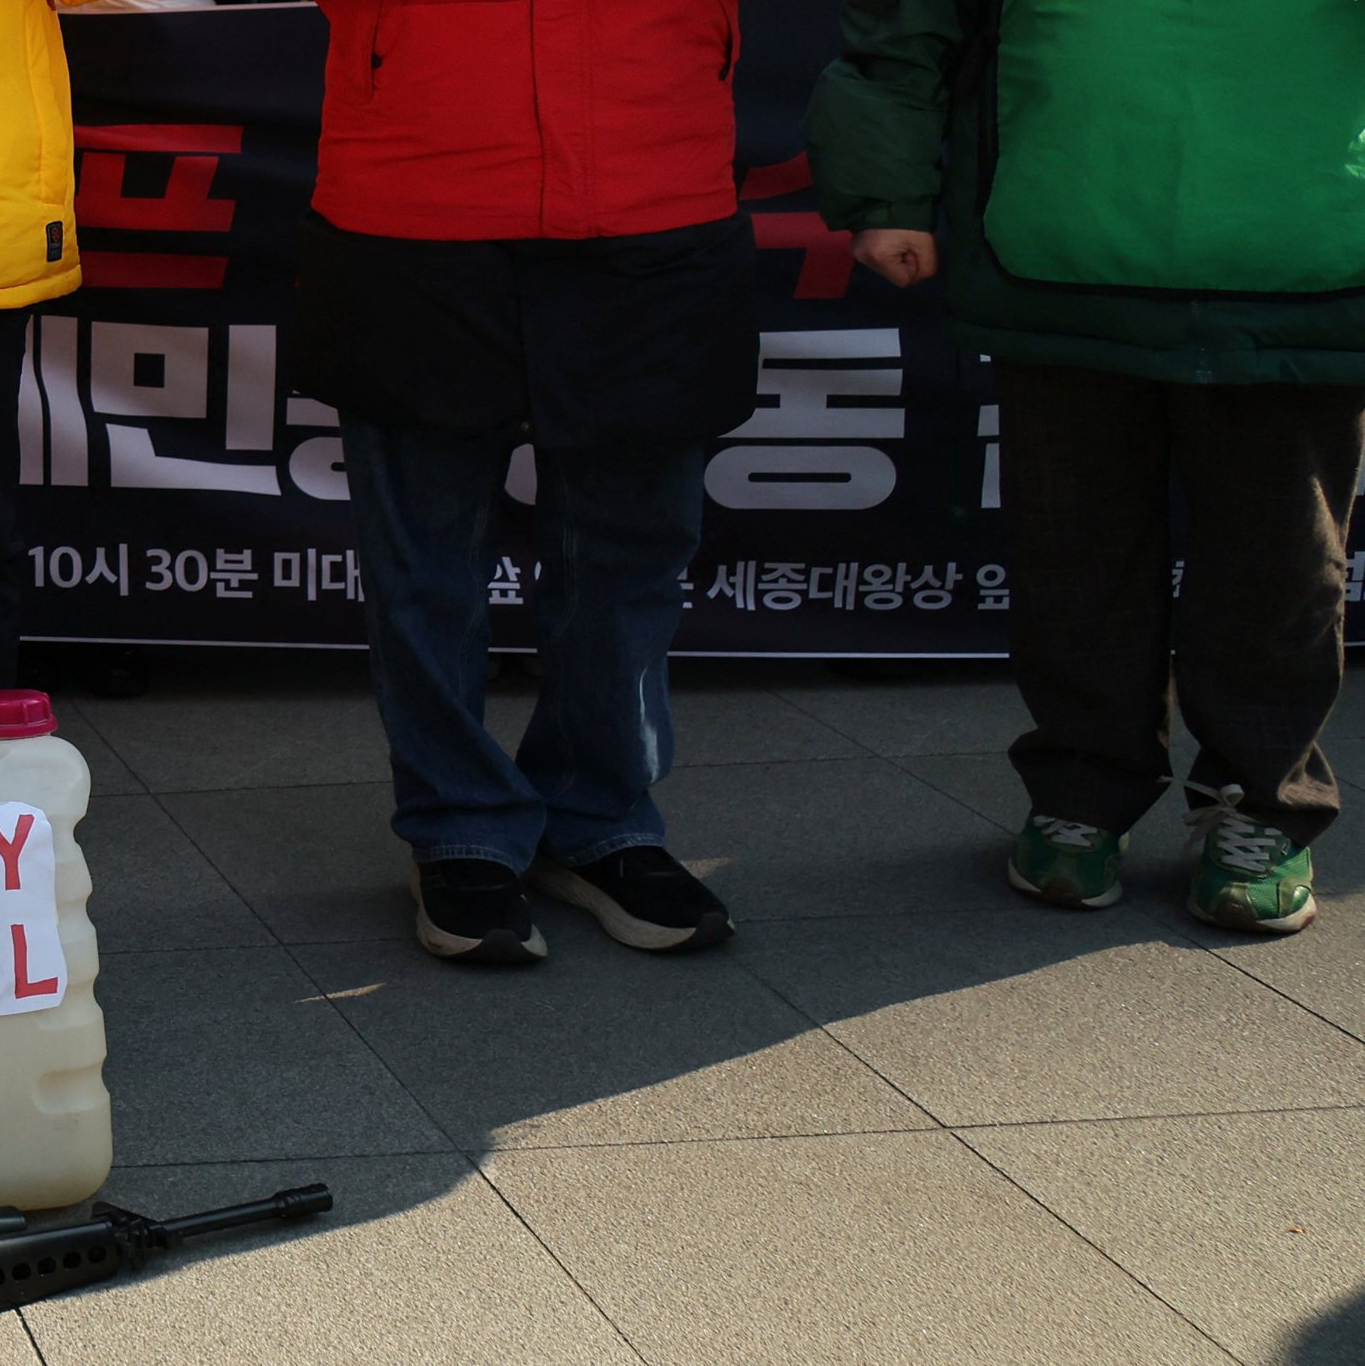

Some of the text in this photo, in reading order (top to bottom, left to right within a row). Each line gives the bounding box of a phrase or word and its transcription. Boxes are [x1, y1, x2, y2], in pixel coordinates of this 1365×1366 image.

[28, 543, 130, 596] 10시
[145, 548, 259, 600] 30분
[274, 548, 365, 602] 미대
[707, 561, 962, 612] 세종대왕상
